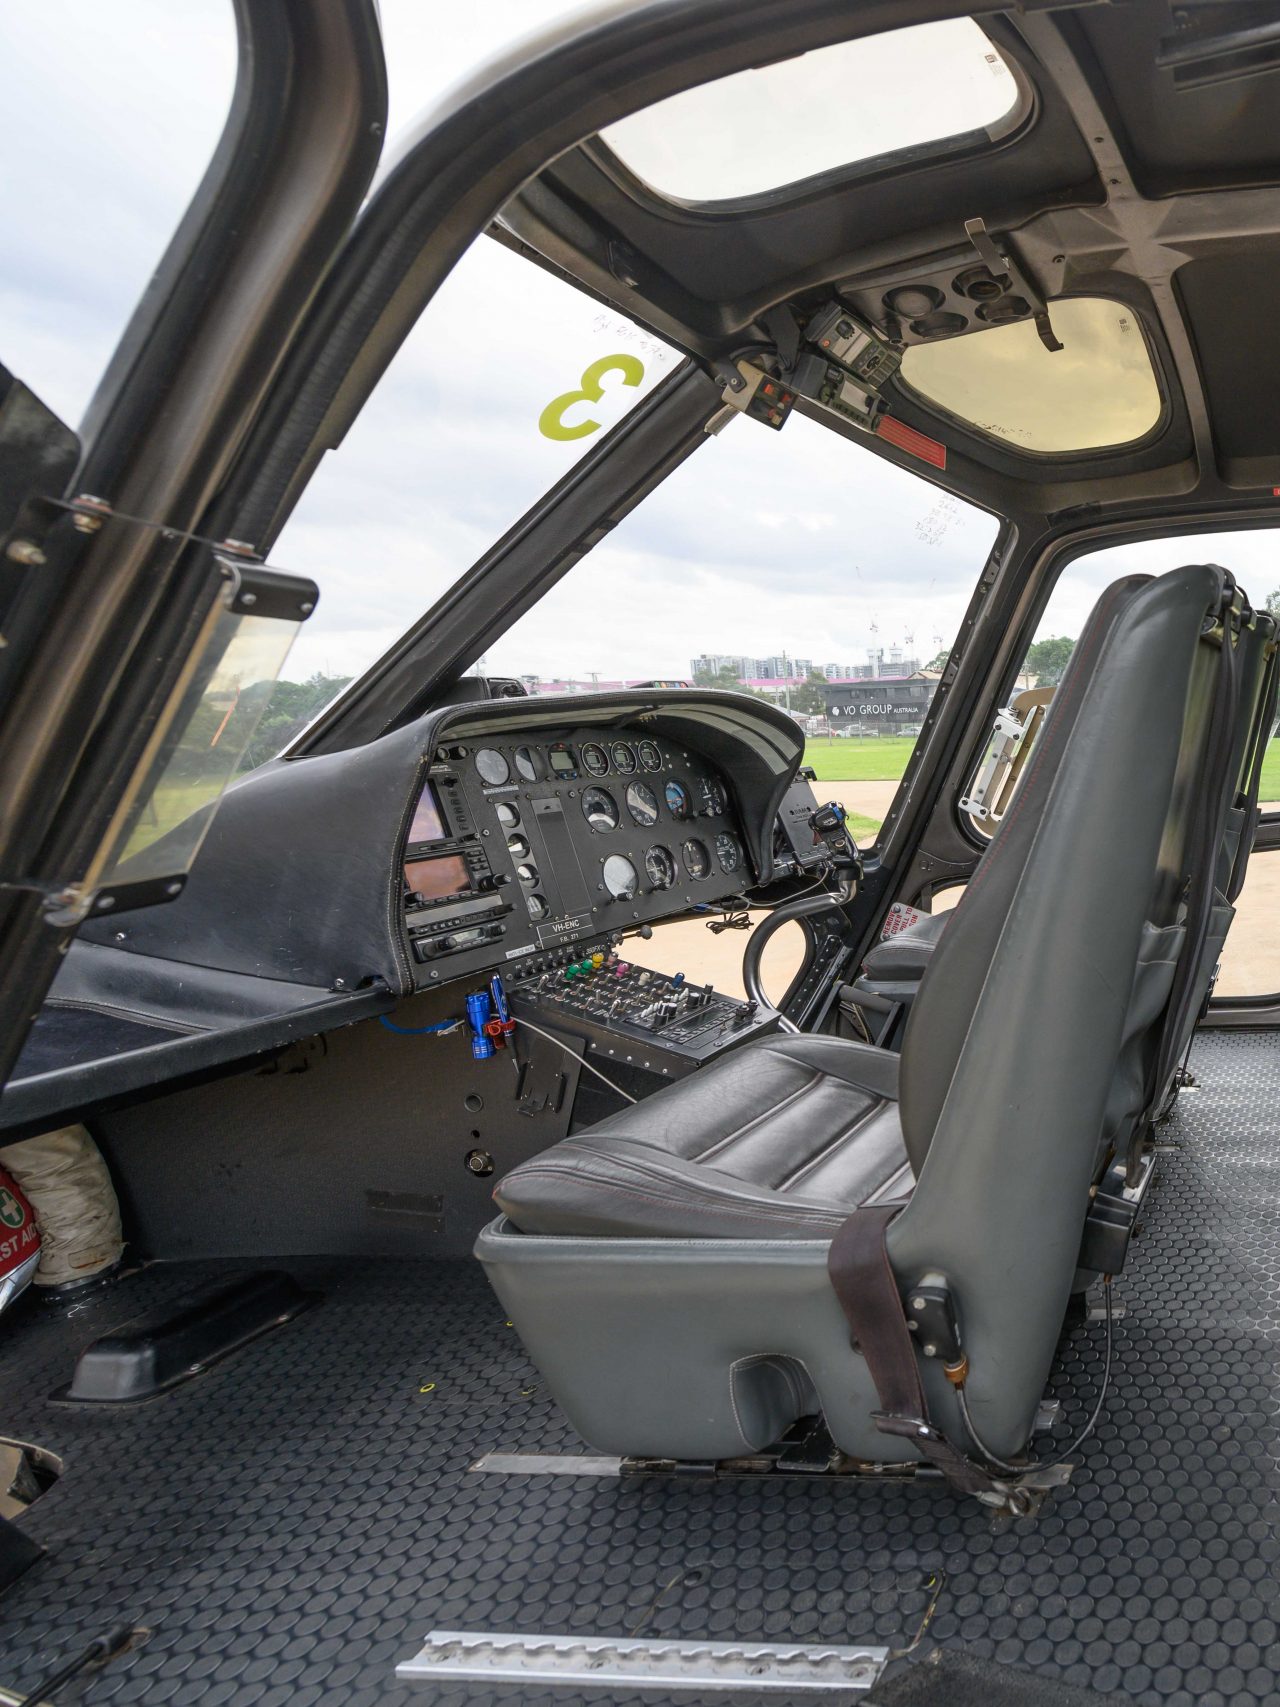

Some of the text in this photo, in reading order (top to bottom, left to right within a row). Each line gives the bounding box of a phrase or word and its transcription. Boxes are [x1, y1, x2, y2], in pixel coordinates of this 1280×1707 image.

[843, 705, 856, 715] VO
[859, 704, 892, 715] GROUP
[552, 919, 580, 933] VH-ENC
[891, 914, 903, 935] COVER
[22, 1222, 37, 1247] AID
